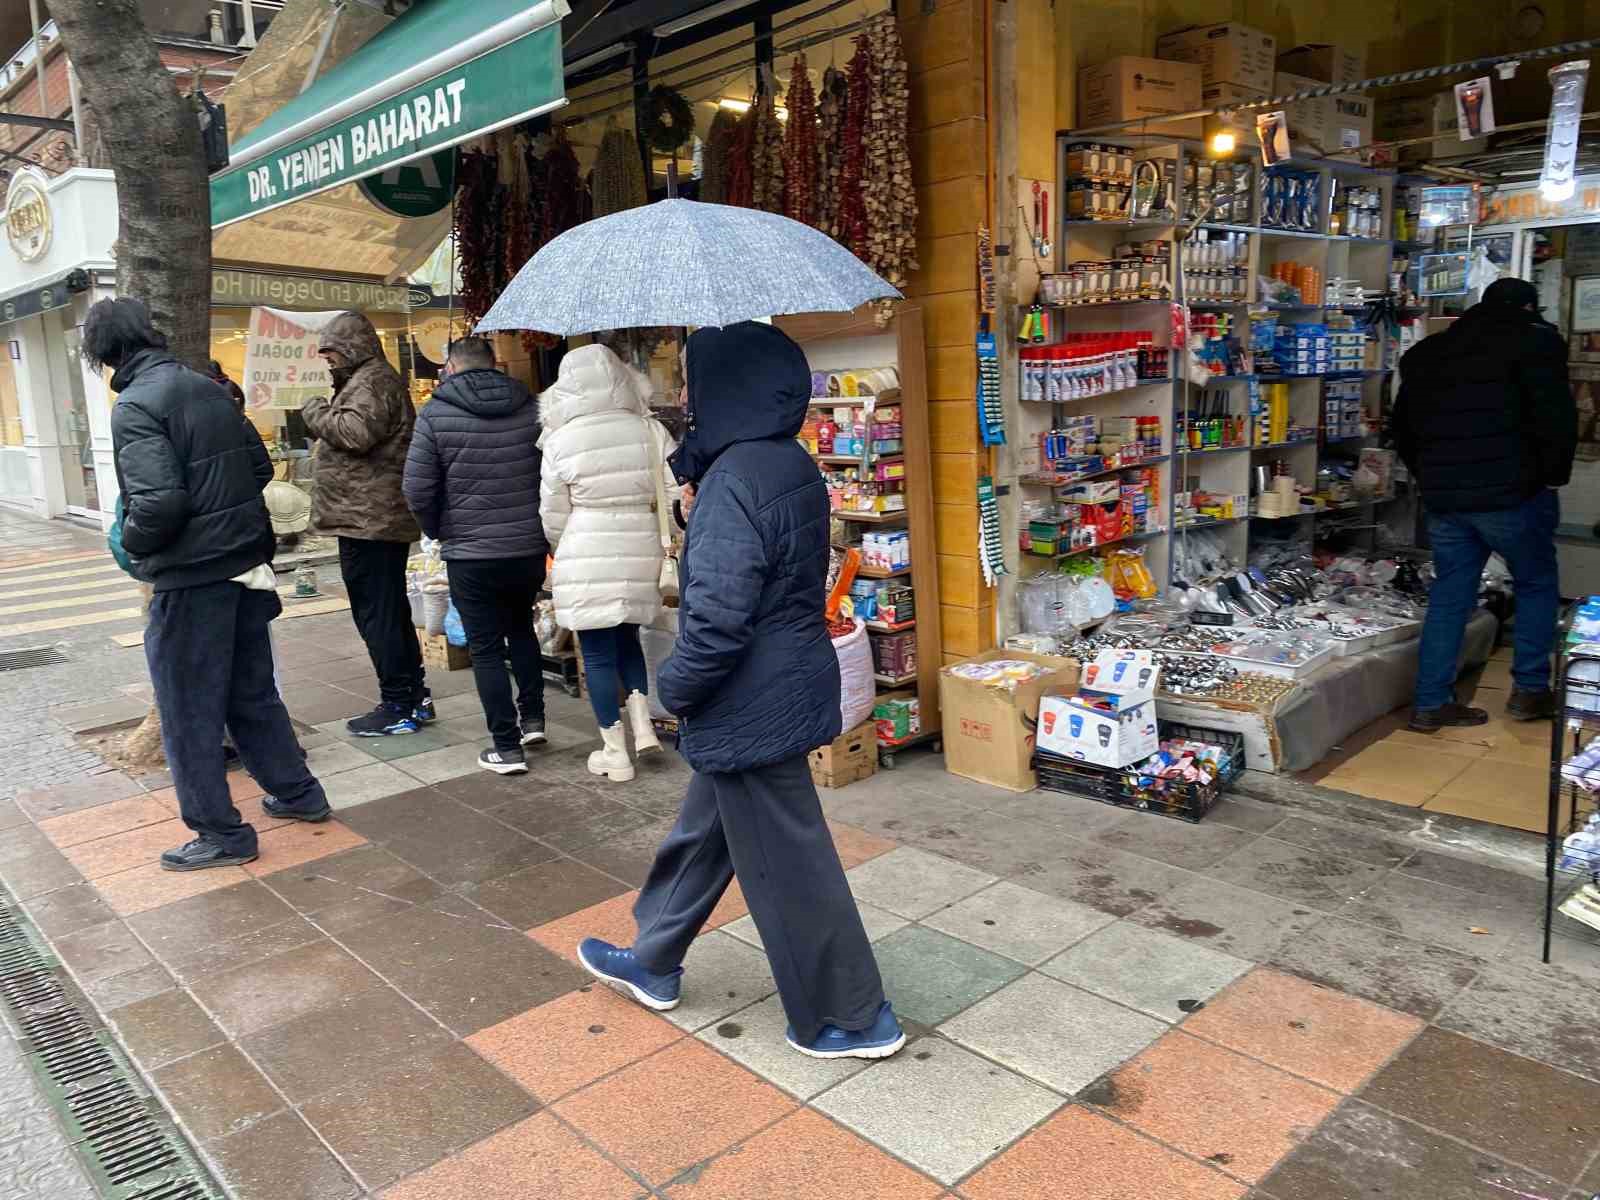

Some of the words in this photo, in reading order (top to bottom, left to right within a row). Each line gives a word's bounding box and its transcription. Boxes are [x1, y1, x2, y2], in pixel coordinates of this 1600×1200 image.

[248, 164, 277, 203] DR.
[277, 133, 345, 192] YEMEN
[350, 78, 466, 165] BAHARAT
